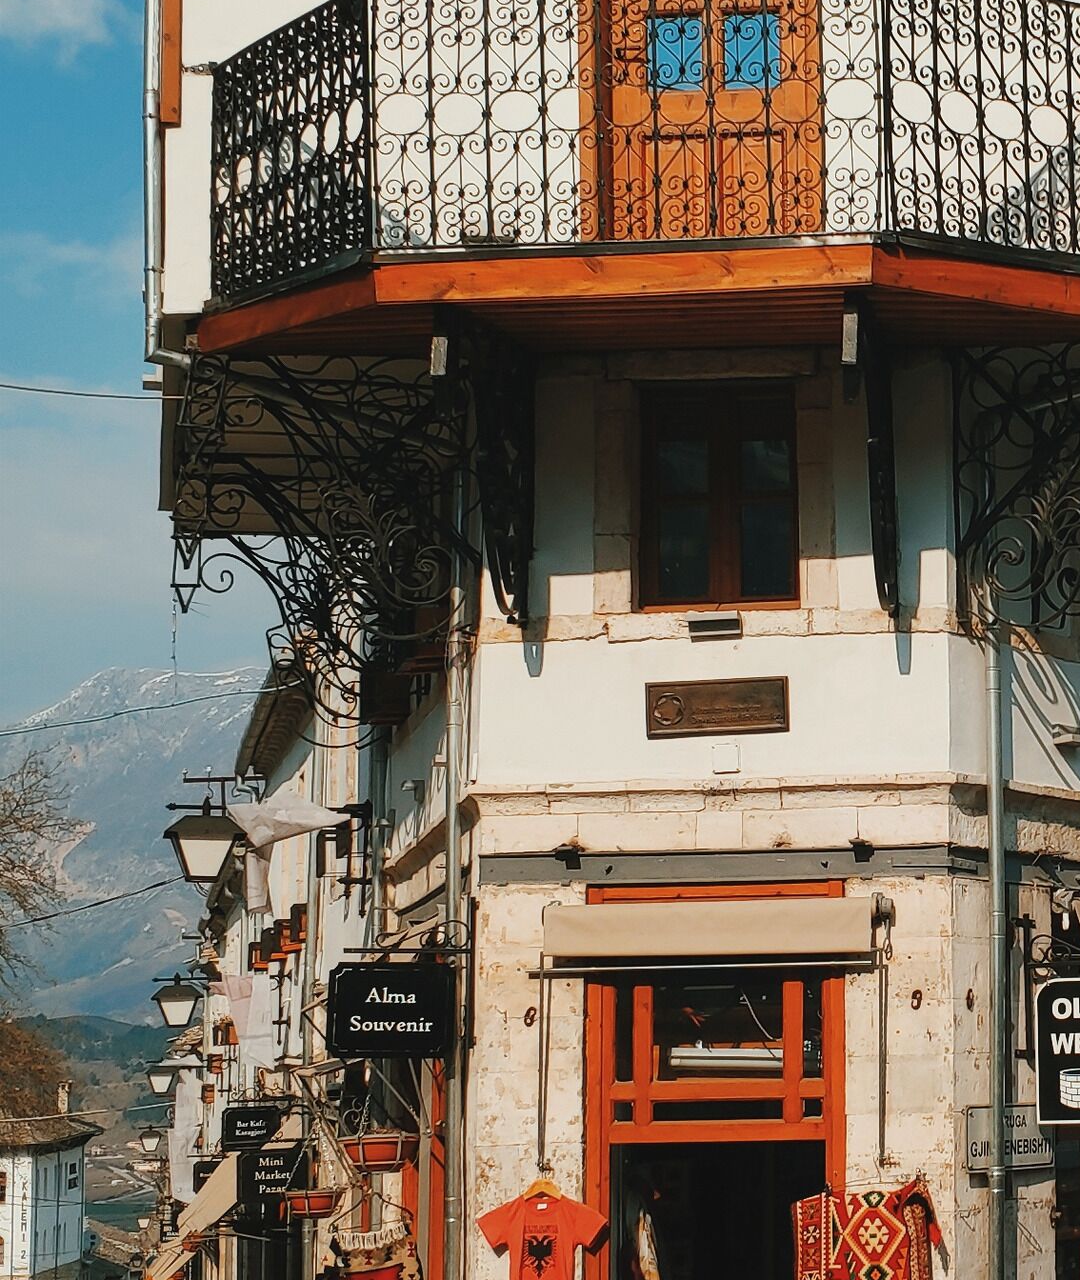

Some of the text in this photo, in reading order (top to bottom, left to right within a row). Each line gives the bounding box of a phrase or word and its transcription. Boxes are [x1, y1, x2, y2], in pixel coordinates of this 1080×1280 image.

[365, 987, 416, 1004] Alma
[350, 1016, 433, 1032] Souvenir
[1003, 1115, 1027, 1129] RUGA
[970, 1138, 1051, 1158] GJI ENEBISHTI
[259, 1157, 284, 1167] Mini
[254, 1170, 291, 1181] Market
